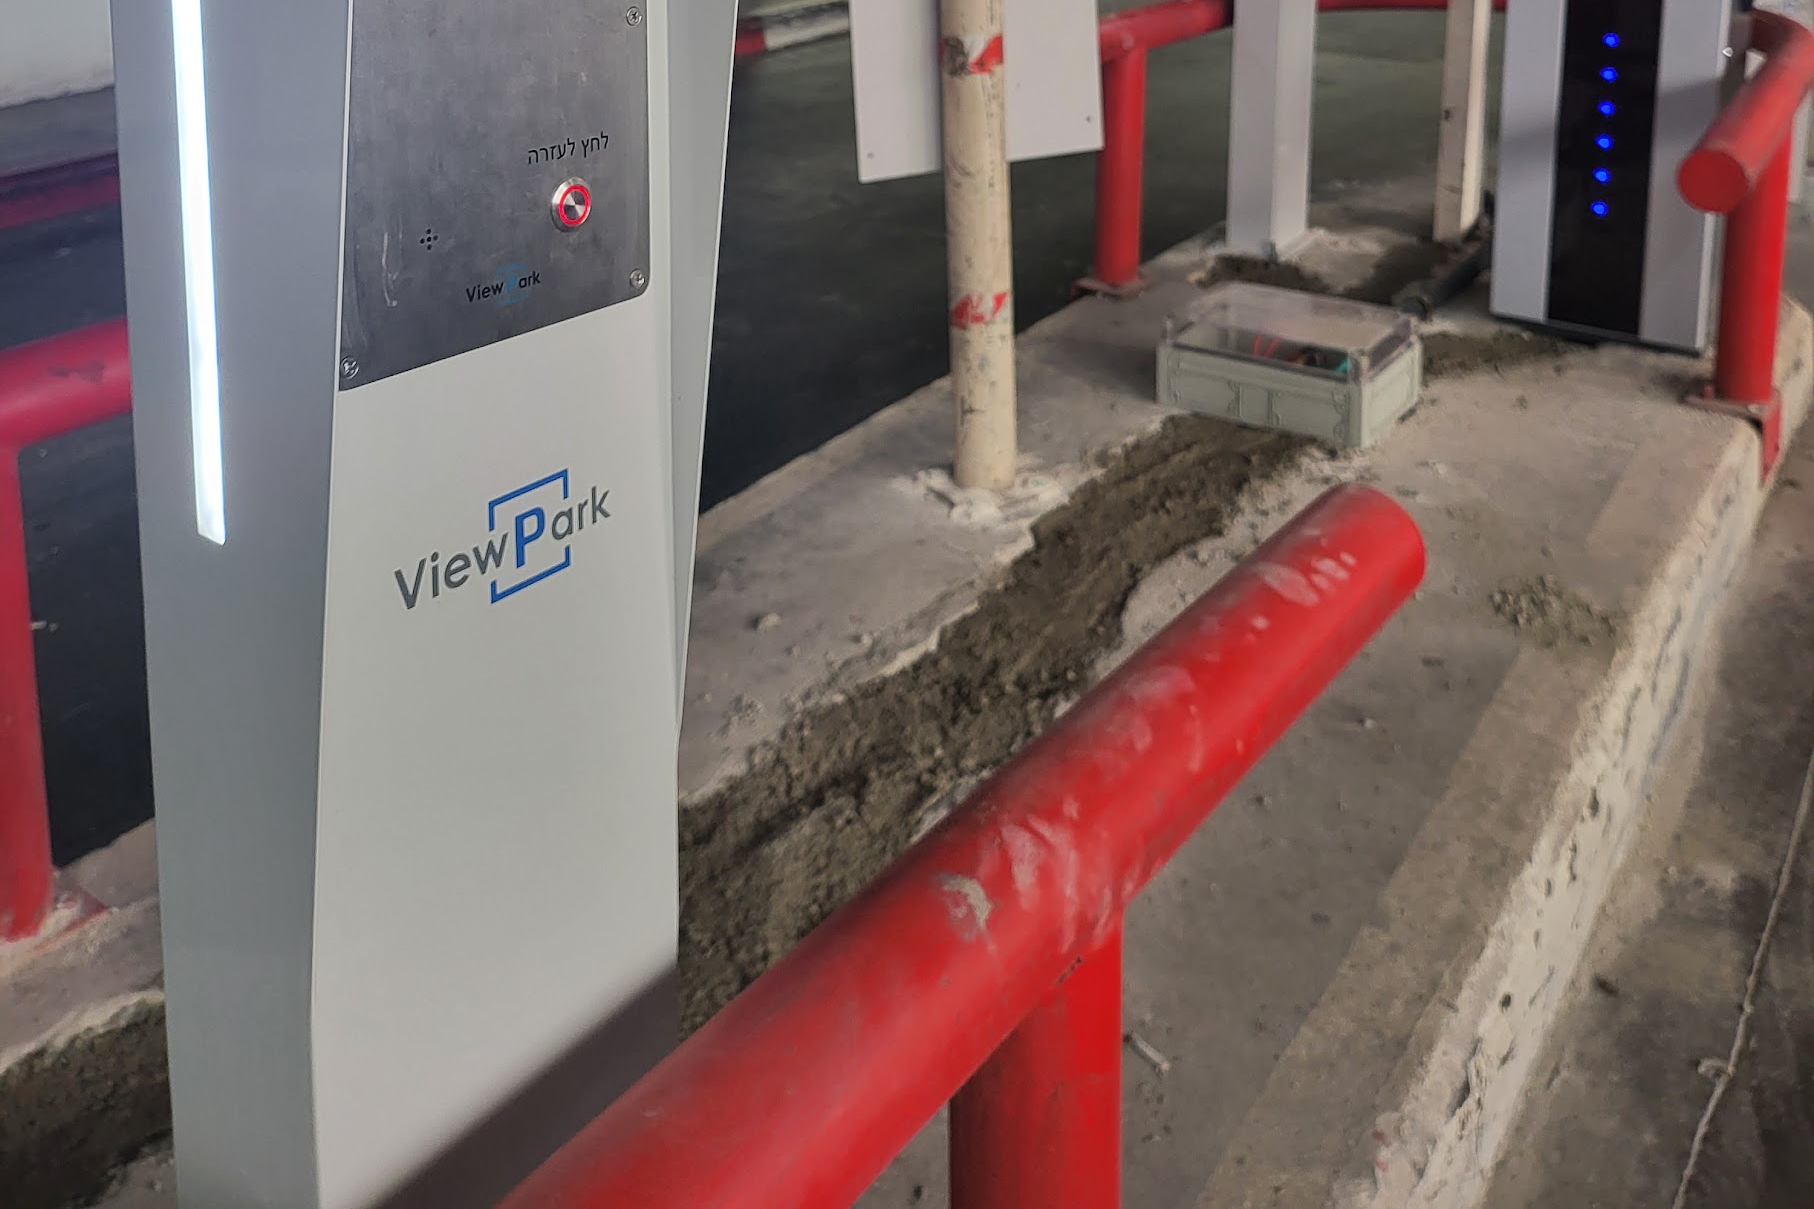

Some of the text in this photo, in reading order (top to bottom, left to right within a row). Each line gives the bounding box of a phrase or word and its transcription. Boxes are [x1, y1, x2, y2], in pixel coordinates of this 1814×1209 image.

[528, 131, 609, 165] לחץ לעזרה
[394, 485, 611, 610] ViewPark
